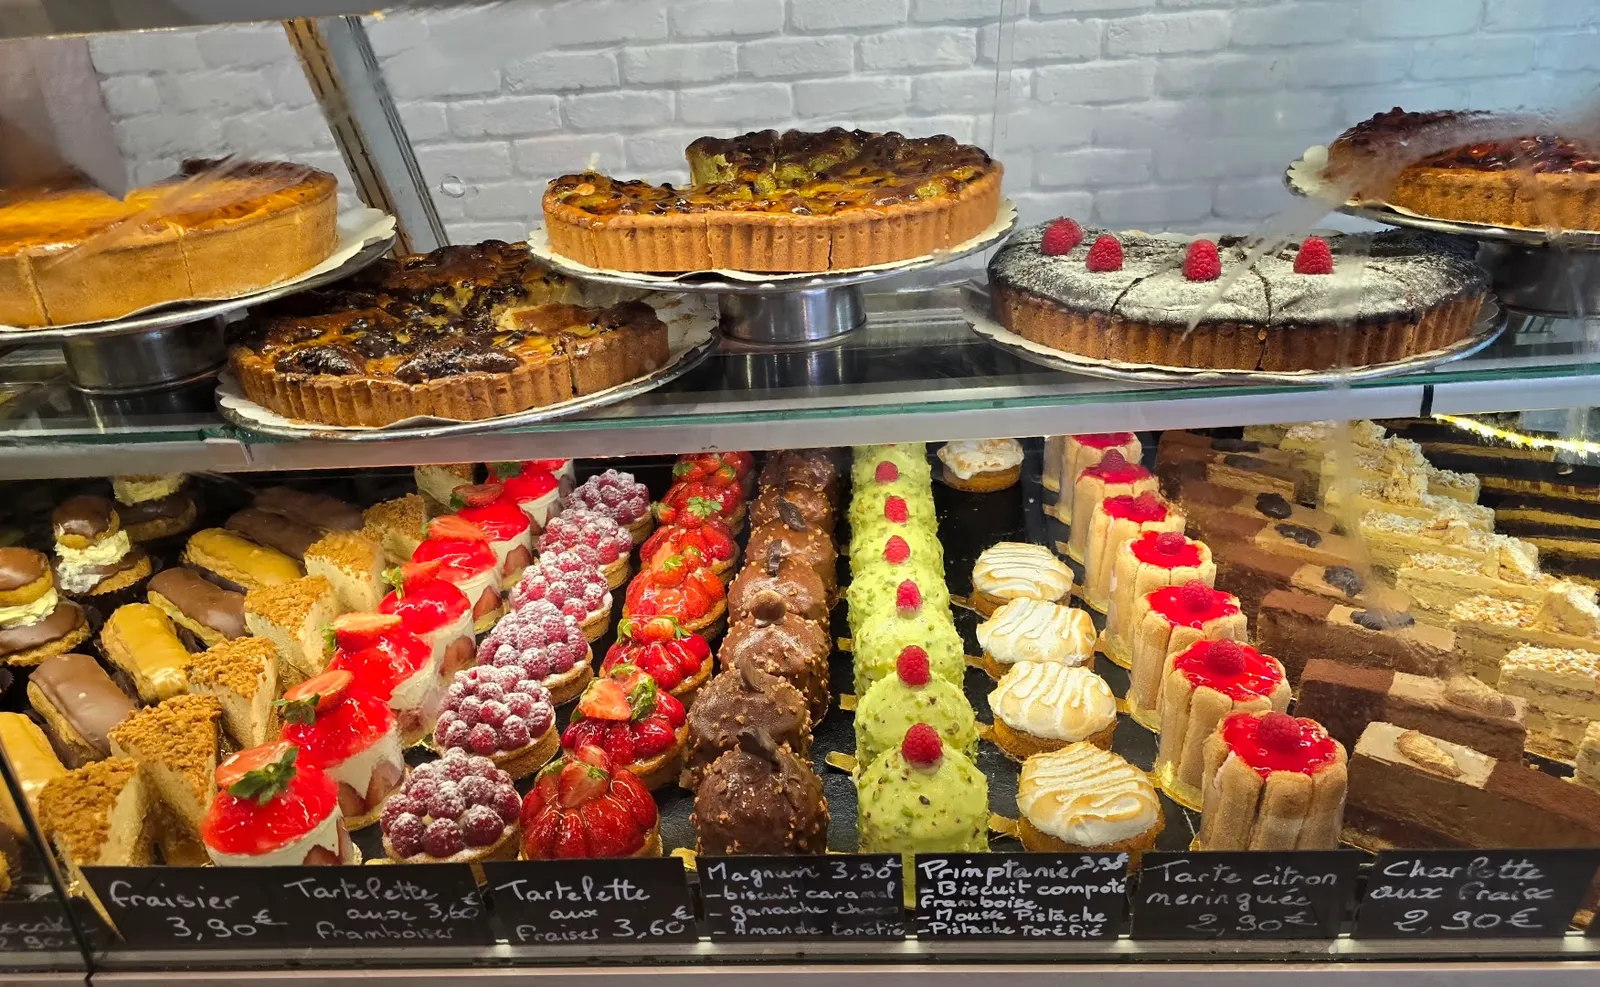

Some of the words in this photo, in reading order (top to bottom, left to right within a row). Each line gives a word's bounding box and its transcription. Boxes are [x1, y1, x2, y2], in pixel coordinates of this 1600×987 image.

[1143, 859, 1242, 883] Tarte
[1252, 865, 1339, 886] citron
[283, 877, 439, 900] Tartelette
[495, 875, 651, 902] Tartelette
[549, 909, 599, 920] aux
